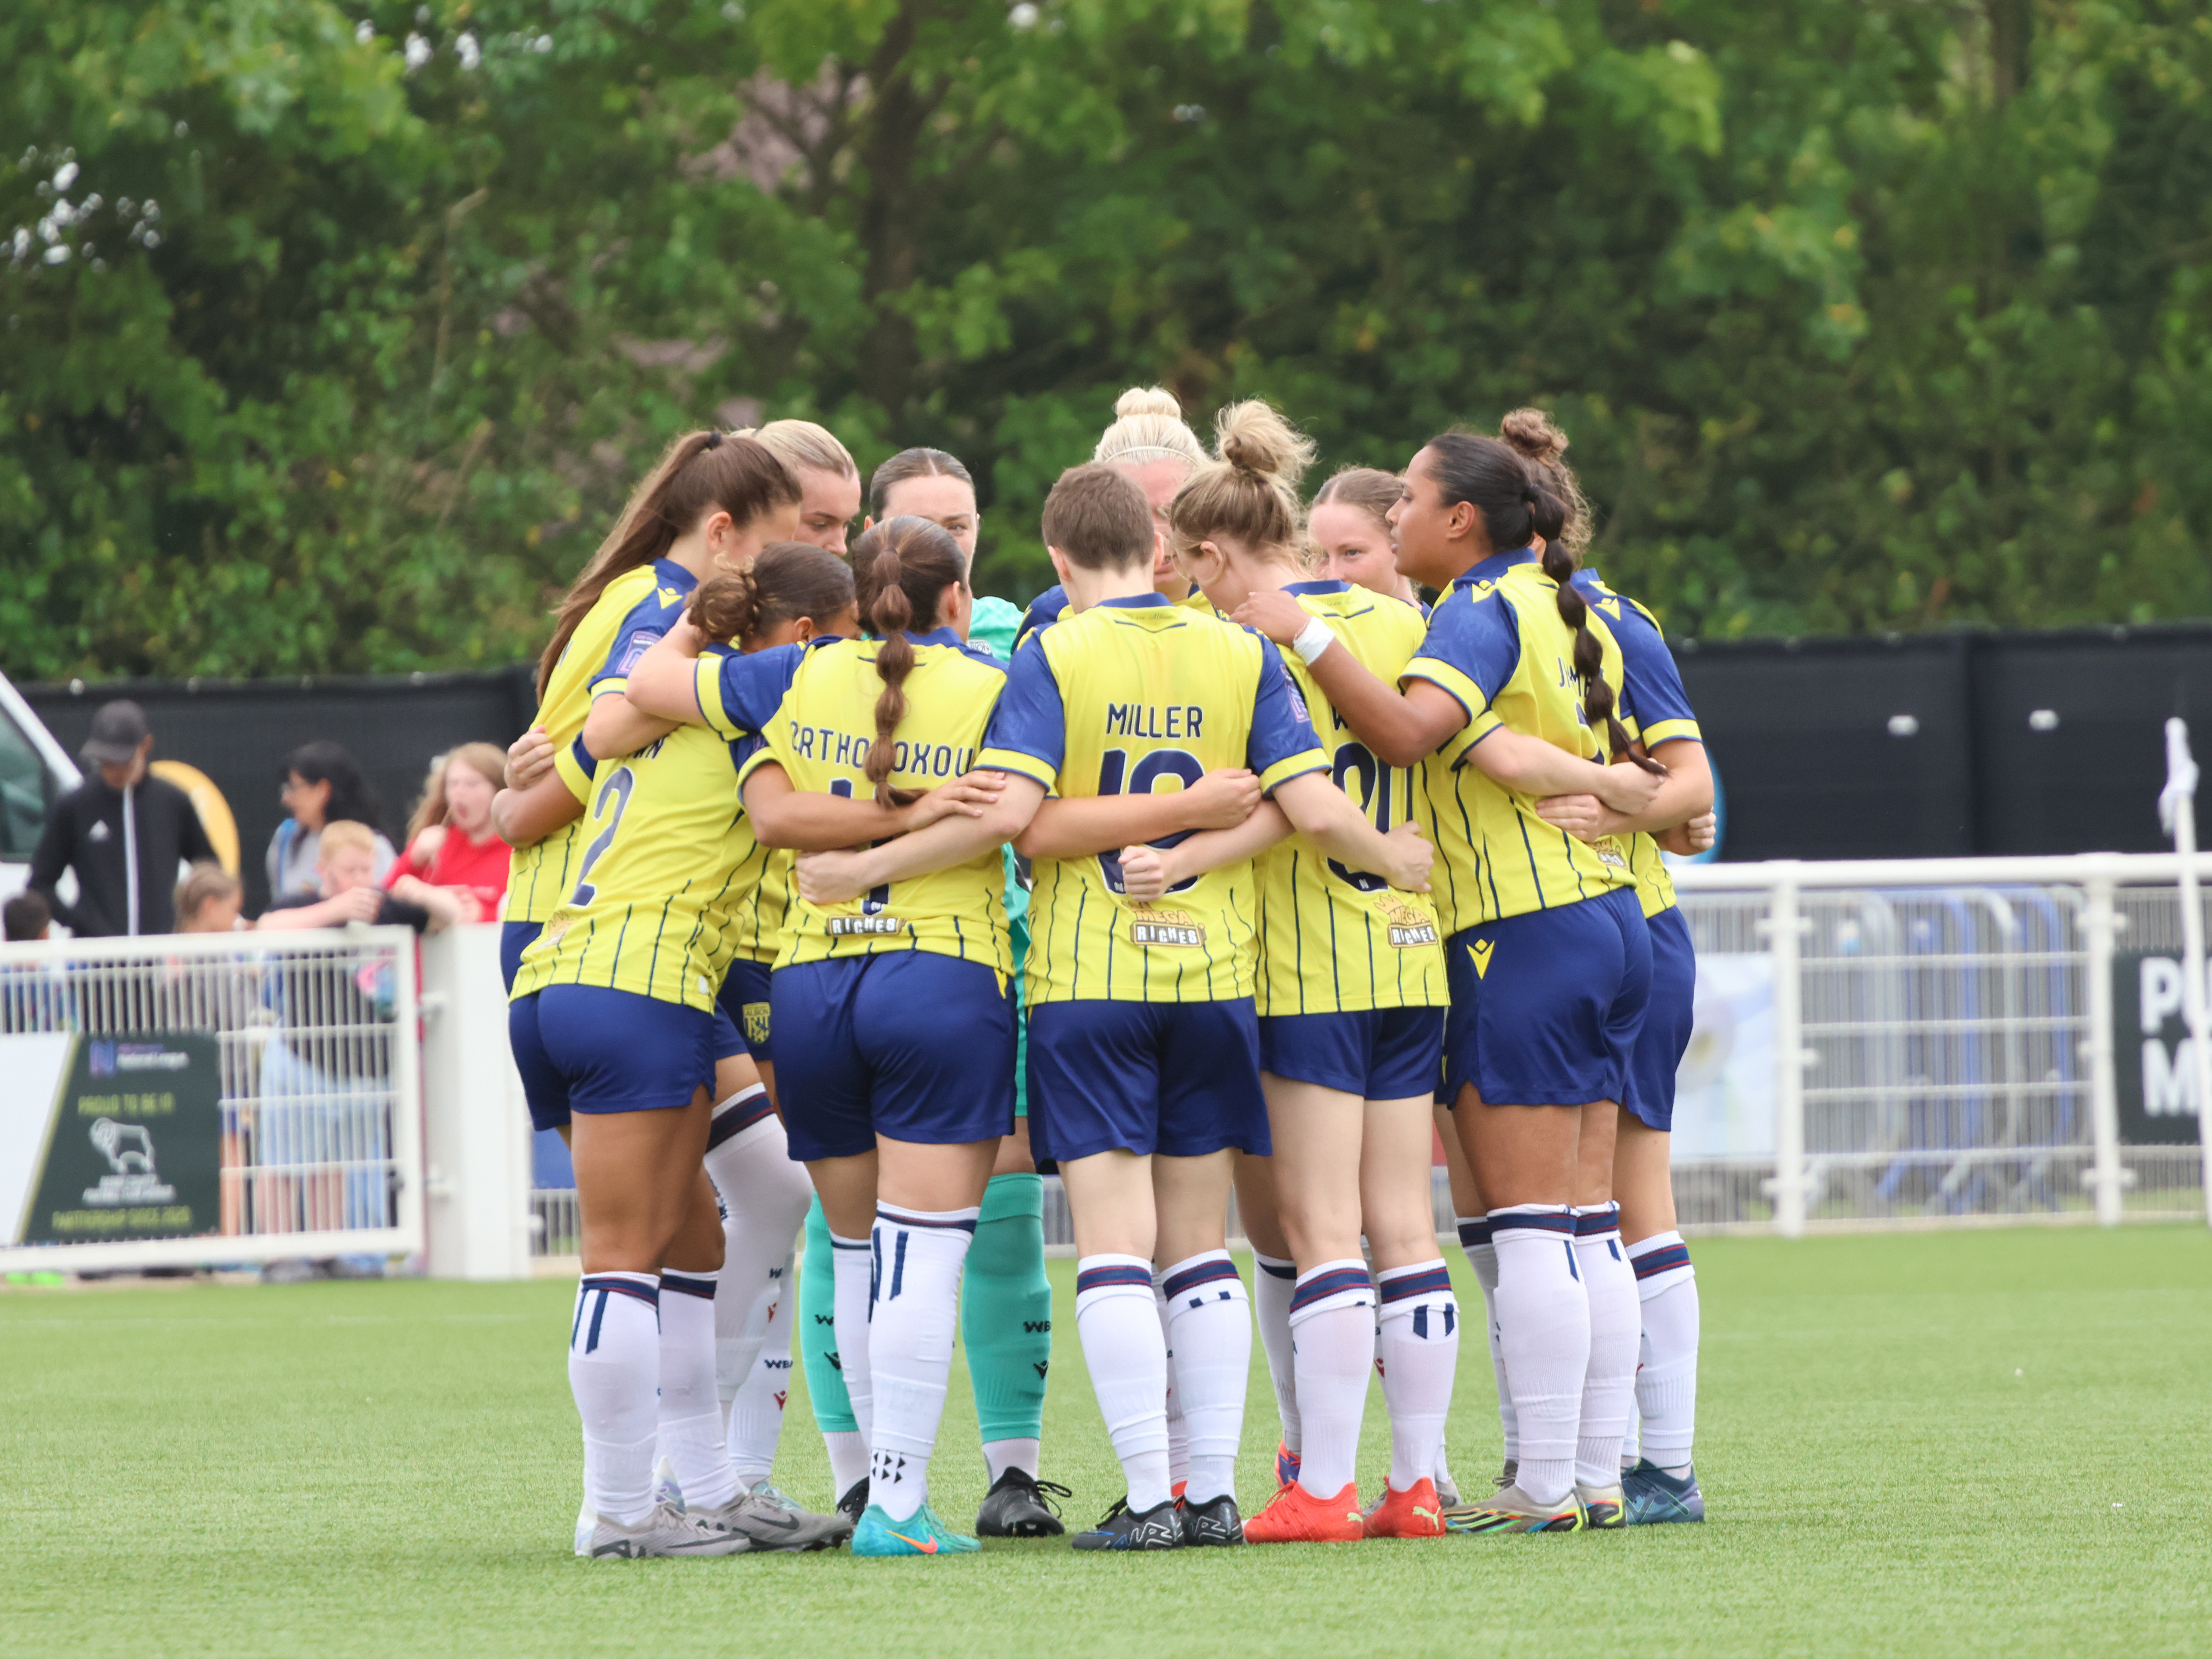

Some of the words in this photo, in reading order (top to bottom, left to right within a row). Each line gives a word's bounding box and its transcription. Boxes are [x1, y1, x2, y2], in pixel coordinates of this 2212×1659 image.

[1106, 702, 1204, 739] MILLER
[790, 719, 974, 778] ORTHOOXOU
[568, 765, 635, 908] 2
[1135, 909, 1194, 926] MEGA
[1389, 906, 1430, 925] MEGA
[831, 917, 897, 934] RICHES
[1137, 925, 1199, 944] RICHES
[1392, 926, 1435, 944] RICHES
[1023, 1320, 1052, 1333] WB
